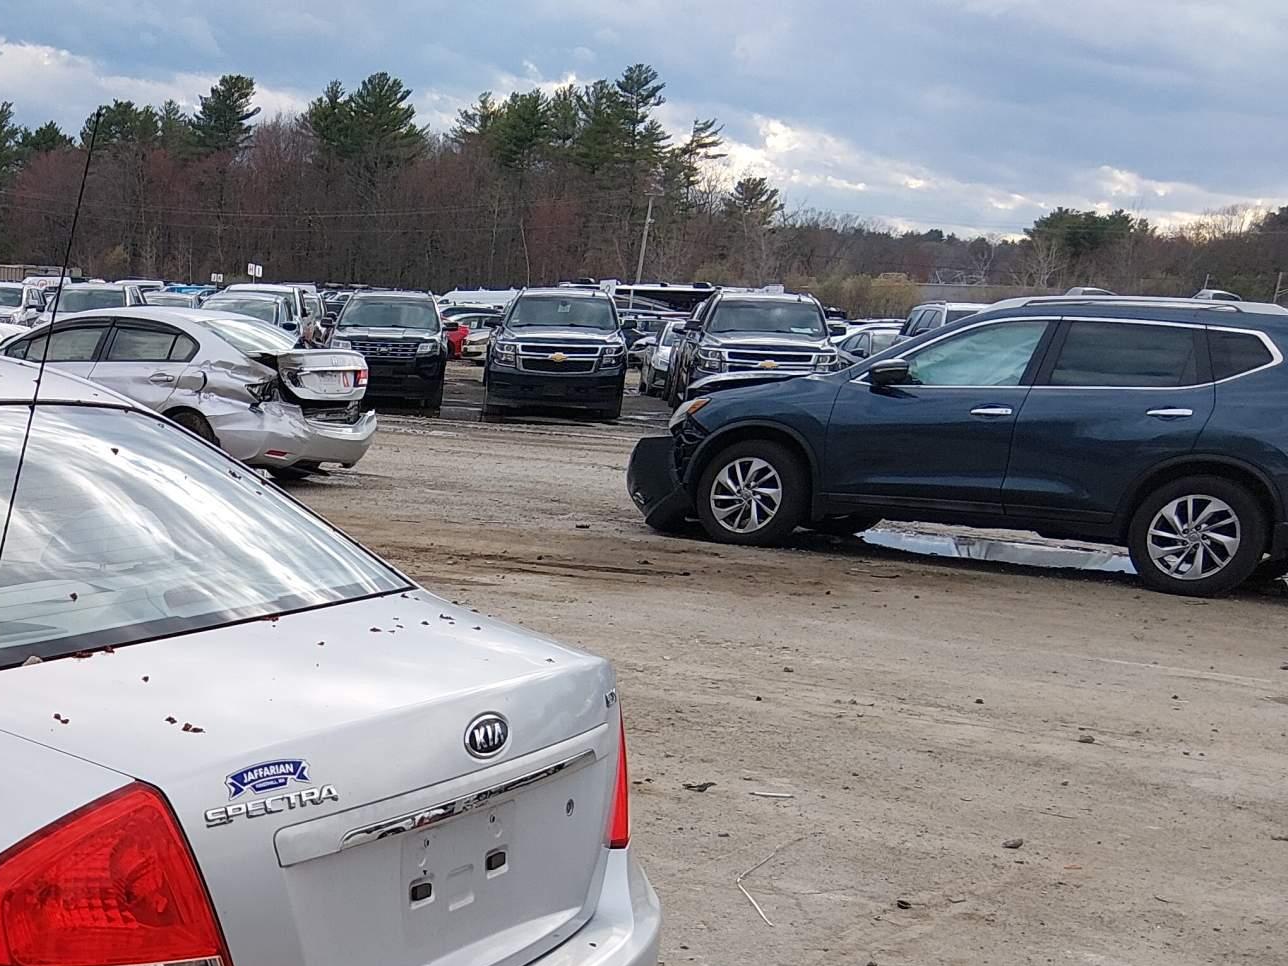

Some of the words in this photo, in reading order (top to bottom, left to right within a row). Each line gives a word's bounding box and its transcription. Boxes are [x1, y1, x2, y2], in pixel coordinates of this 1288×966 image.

[473, 722, 504, 750] KIA
[243, 763, 294, 783] JAFFARIAN
[205, 784, 339, 828] SPECTRA
